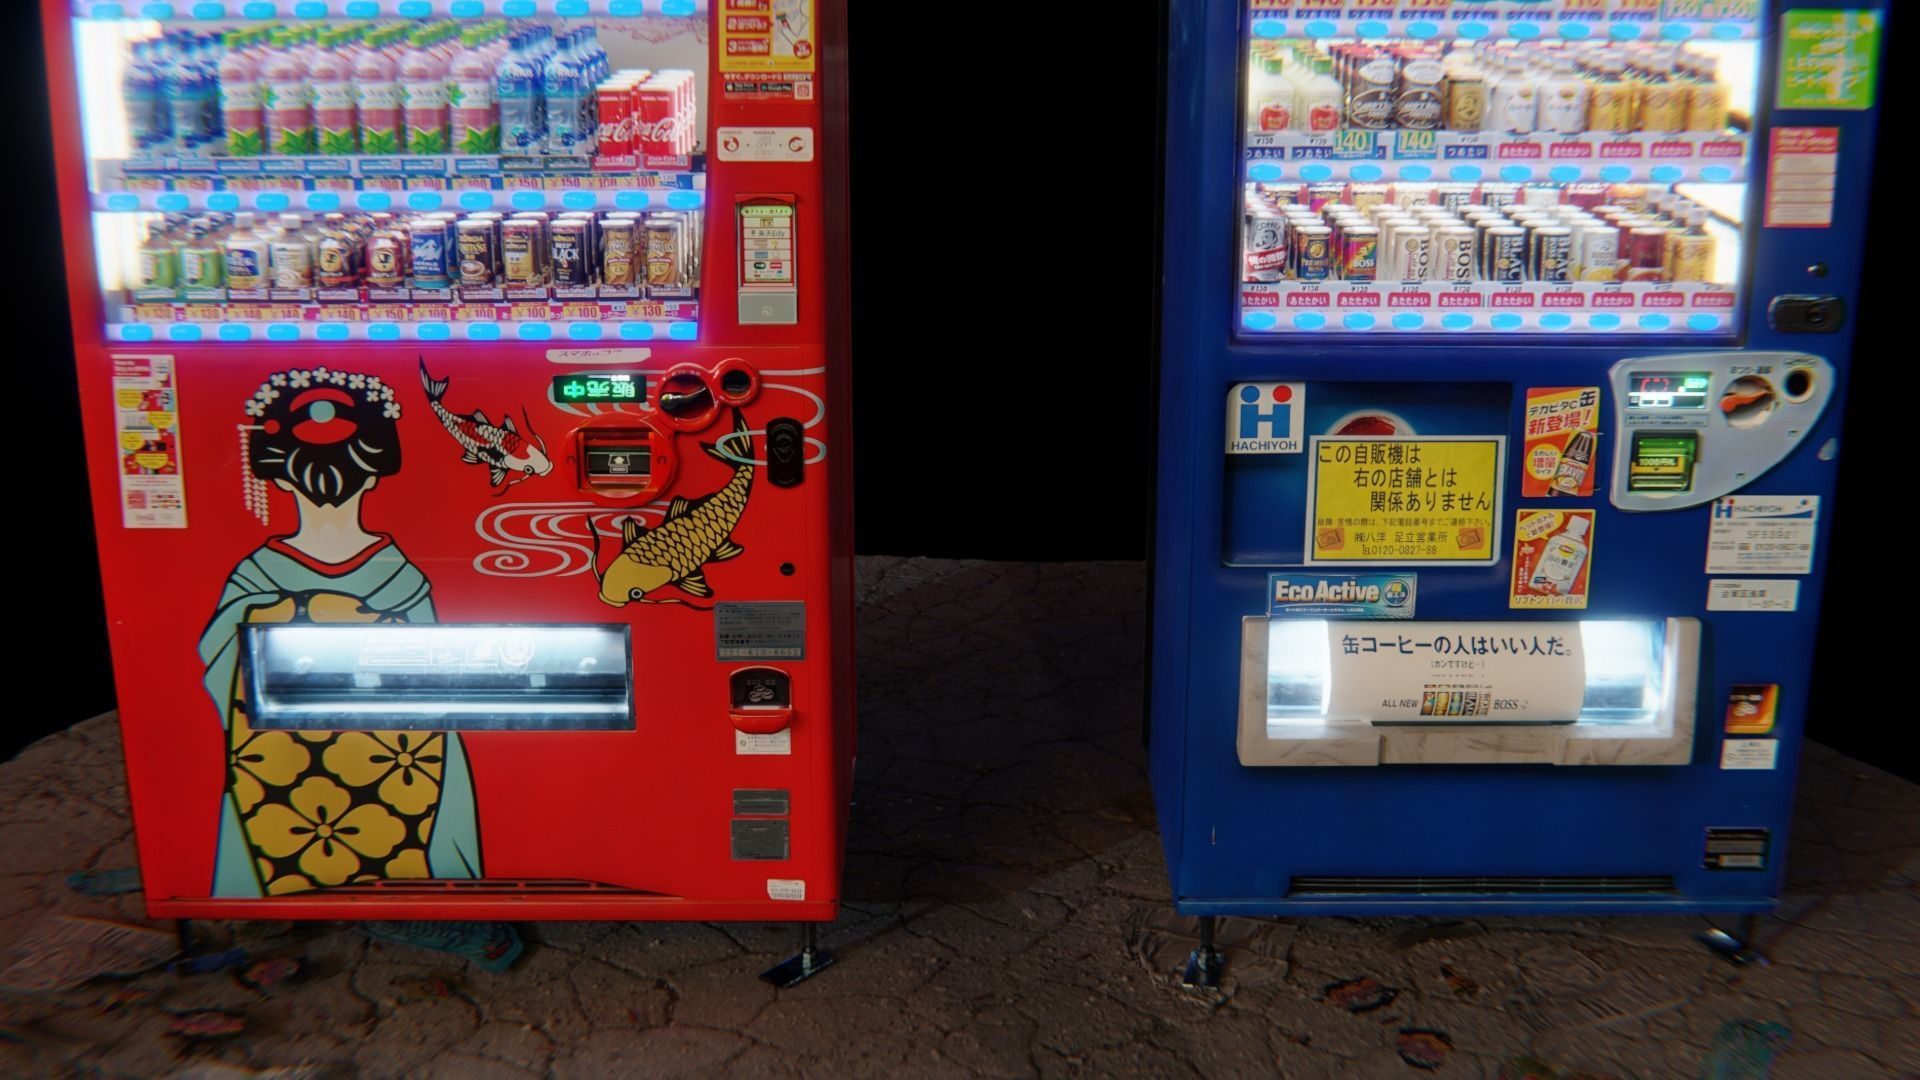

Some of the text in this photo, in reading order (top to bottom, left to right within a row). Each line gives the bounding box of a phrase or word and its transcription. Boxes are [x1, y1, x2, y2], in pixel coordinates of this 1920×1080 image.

[1336, 131, 1367, 151] 140
[1401, 131, 1432, 151] 140
[1447, 147, 1485, 157] つめたい
[1353, 260, 1375, 268] BOSS
[1418, 240, 1429, 280] BOS
[1456, 240, 1472, 280] BOS
[1341, 296, 1377, 306] あたたかい
[1391, 296, 1428, 306] あたたかい
[1442, 296, 1479, 306] あたたかい
[1231, 441, 1297, 451] HACHIYOH
[1319, 444, 1421, 465] この自販機は
[1353, 466, 1457, 488] 右の店舗とは
[1370, 491, 1491, 513] 関係ありません
[1394, 531, 1449, 543] 足立営業所
[1341, 635, 1573, 656] 缶コーヒーの人はいい人だ。
[1382, 699, 1418, 708] ALL NEW
[1493, 699, 1518, 710] BOSS
